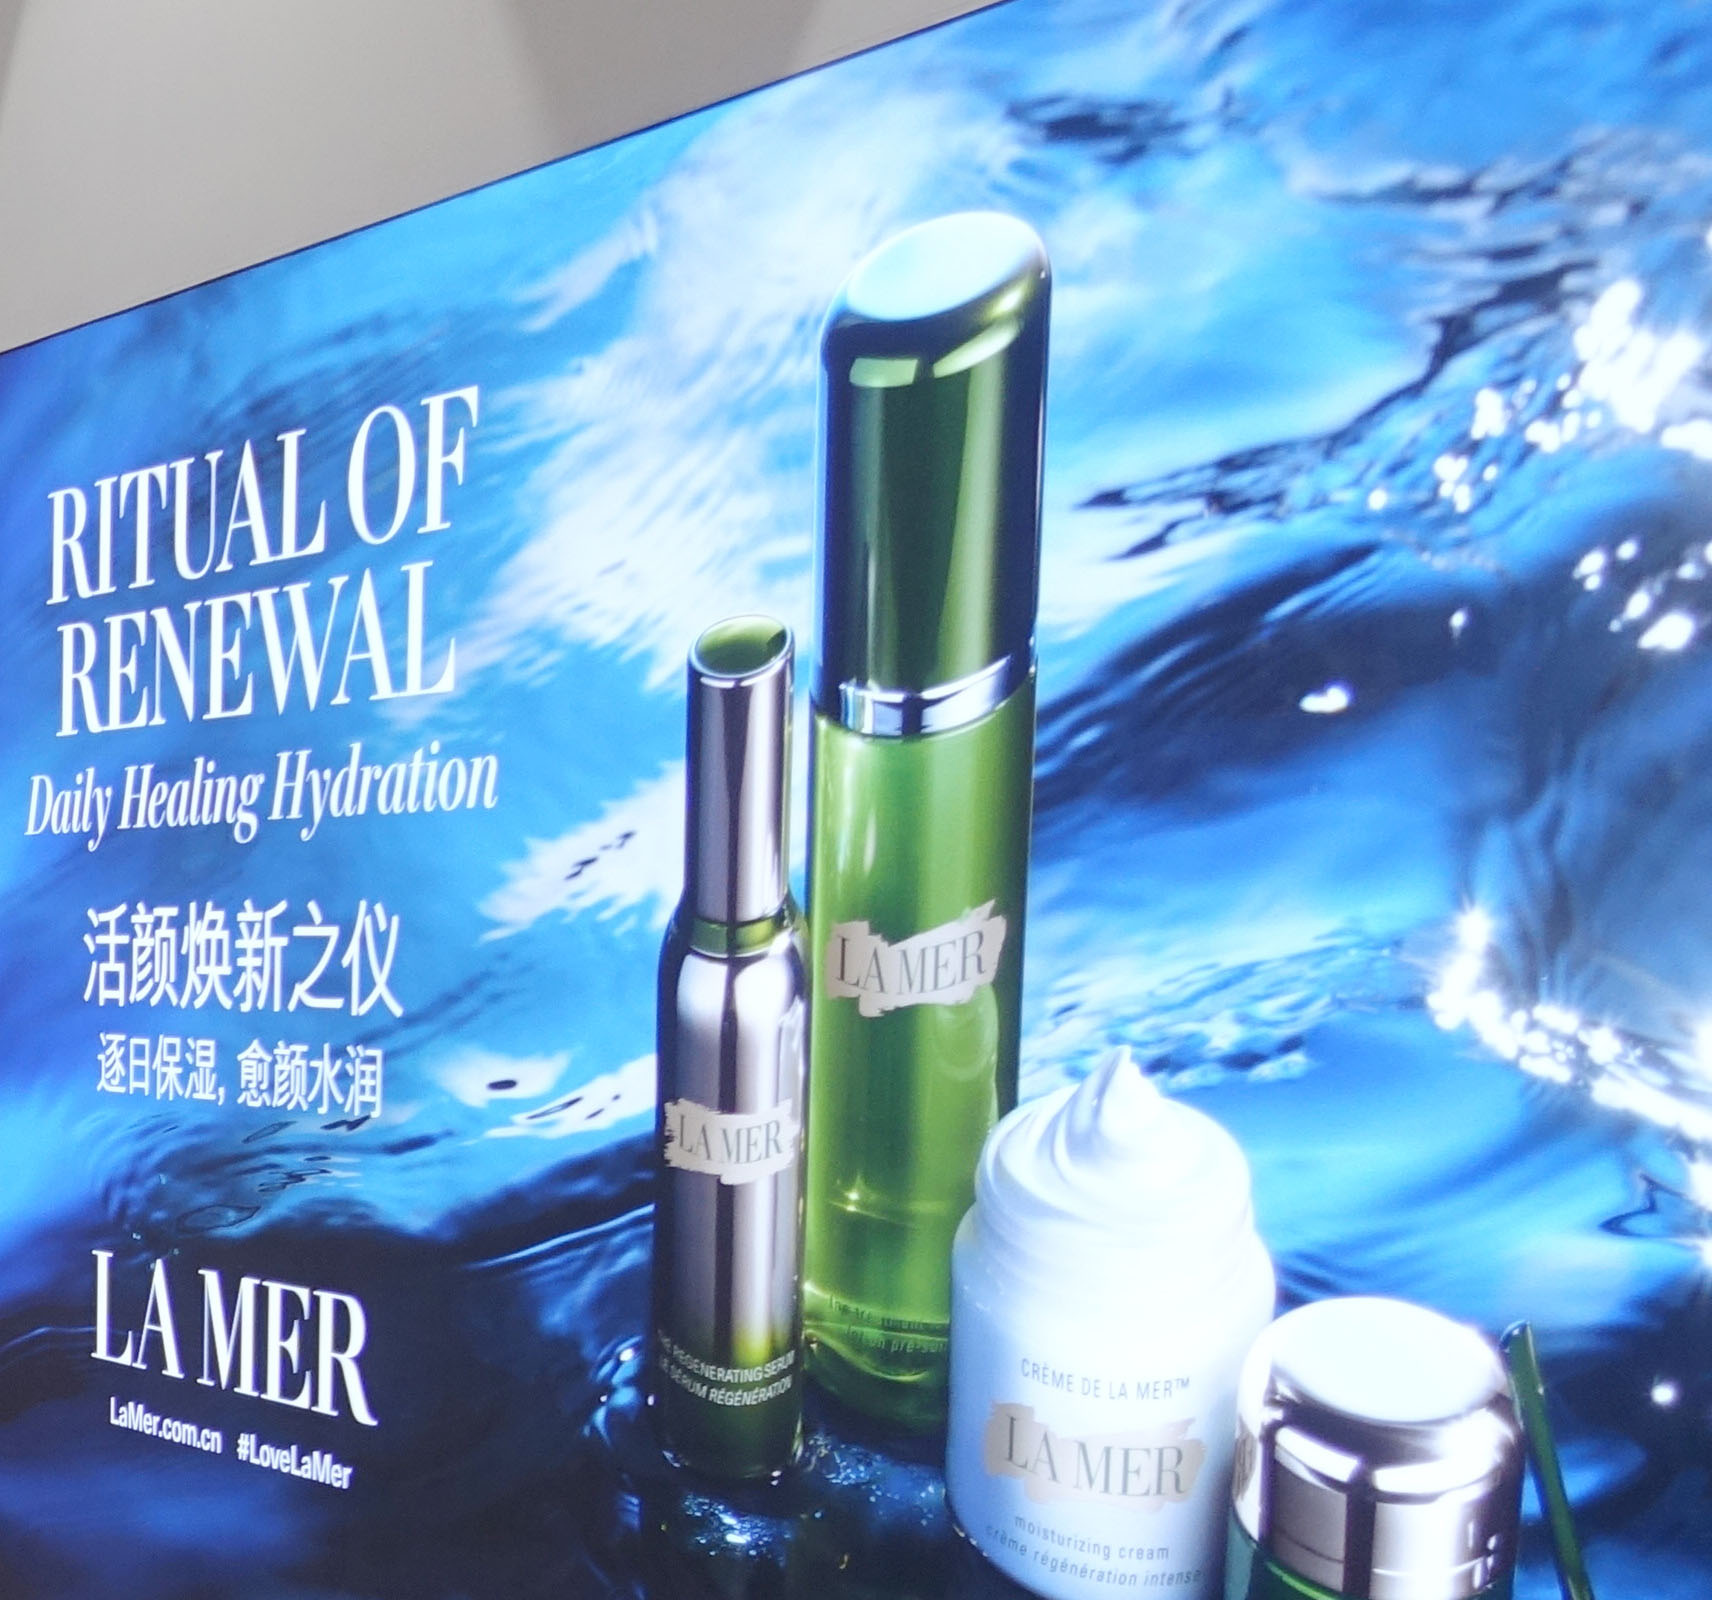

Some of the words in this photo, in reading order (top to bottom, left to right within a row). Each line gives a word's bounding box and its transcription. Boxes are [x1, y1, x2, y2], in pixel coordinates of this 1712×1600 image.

[46, 429, 327, 606] RITUAL
[347, 385, 478, 545] OF
[56, 560, 456, 737] RENEWAL
[24, 768, 111, 852] Daily
[117, 755, 264, 844] Healing
[267, 740, 498, 841] Hydration
[83, 898, 404, 1018] 活颜焕新之仪
[834, 935, 885, 995] LA
[896, 929, 987, 996] MER
[677, 1113, 713, 1162] LA
[719, 1118, 784, 1165] MER
[91, 1249, 185, 1380] LA
[196, 1268, 378, 1426] MER
[763, 1350, 795, 1377] SERUM
[1021, 1357, 1073, 1393] CRÈME
[1081, 1376, 1101, 1399] DE
[1108, 1381, 1127, 1400] LA
[110, 1396, 223, 1454] LaMer.com.cn
[236, 1432, 353, 1490] #LoveLaMer
[1004, 1414, 1063, 1485] LA
[1072, 1438, 1188, 1497] MER
[984, 1524, 1028, 1556] crème
[1033, 1548, 1138, 1587] régénération
[1143, 1567, 1203, 1587] intense
[1014, 1514, 1112, 1559] moisturizing
[1117, 1545, 1170, 1562] cream
